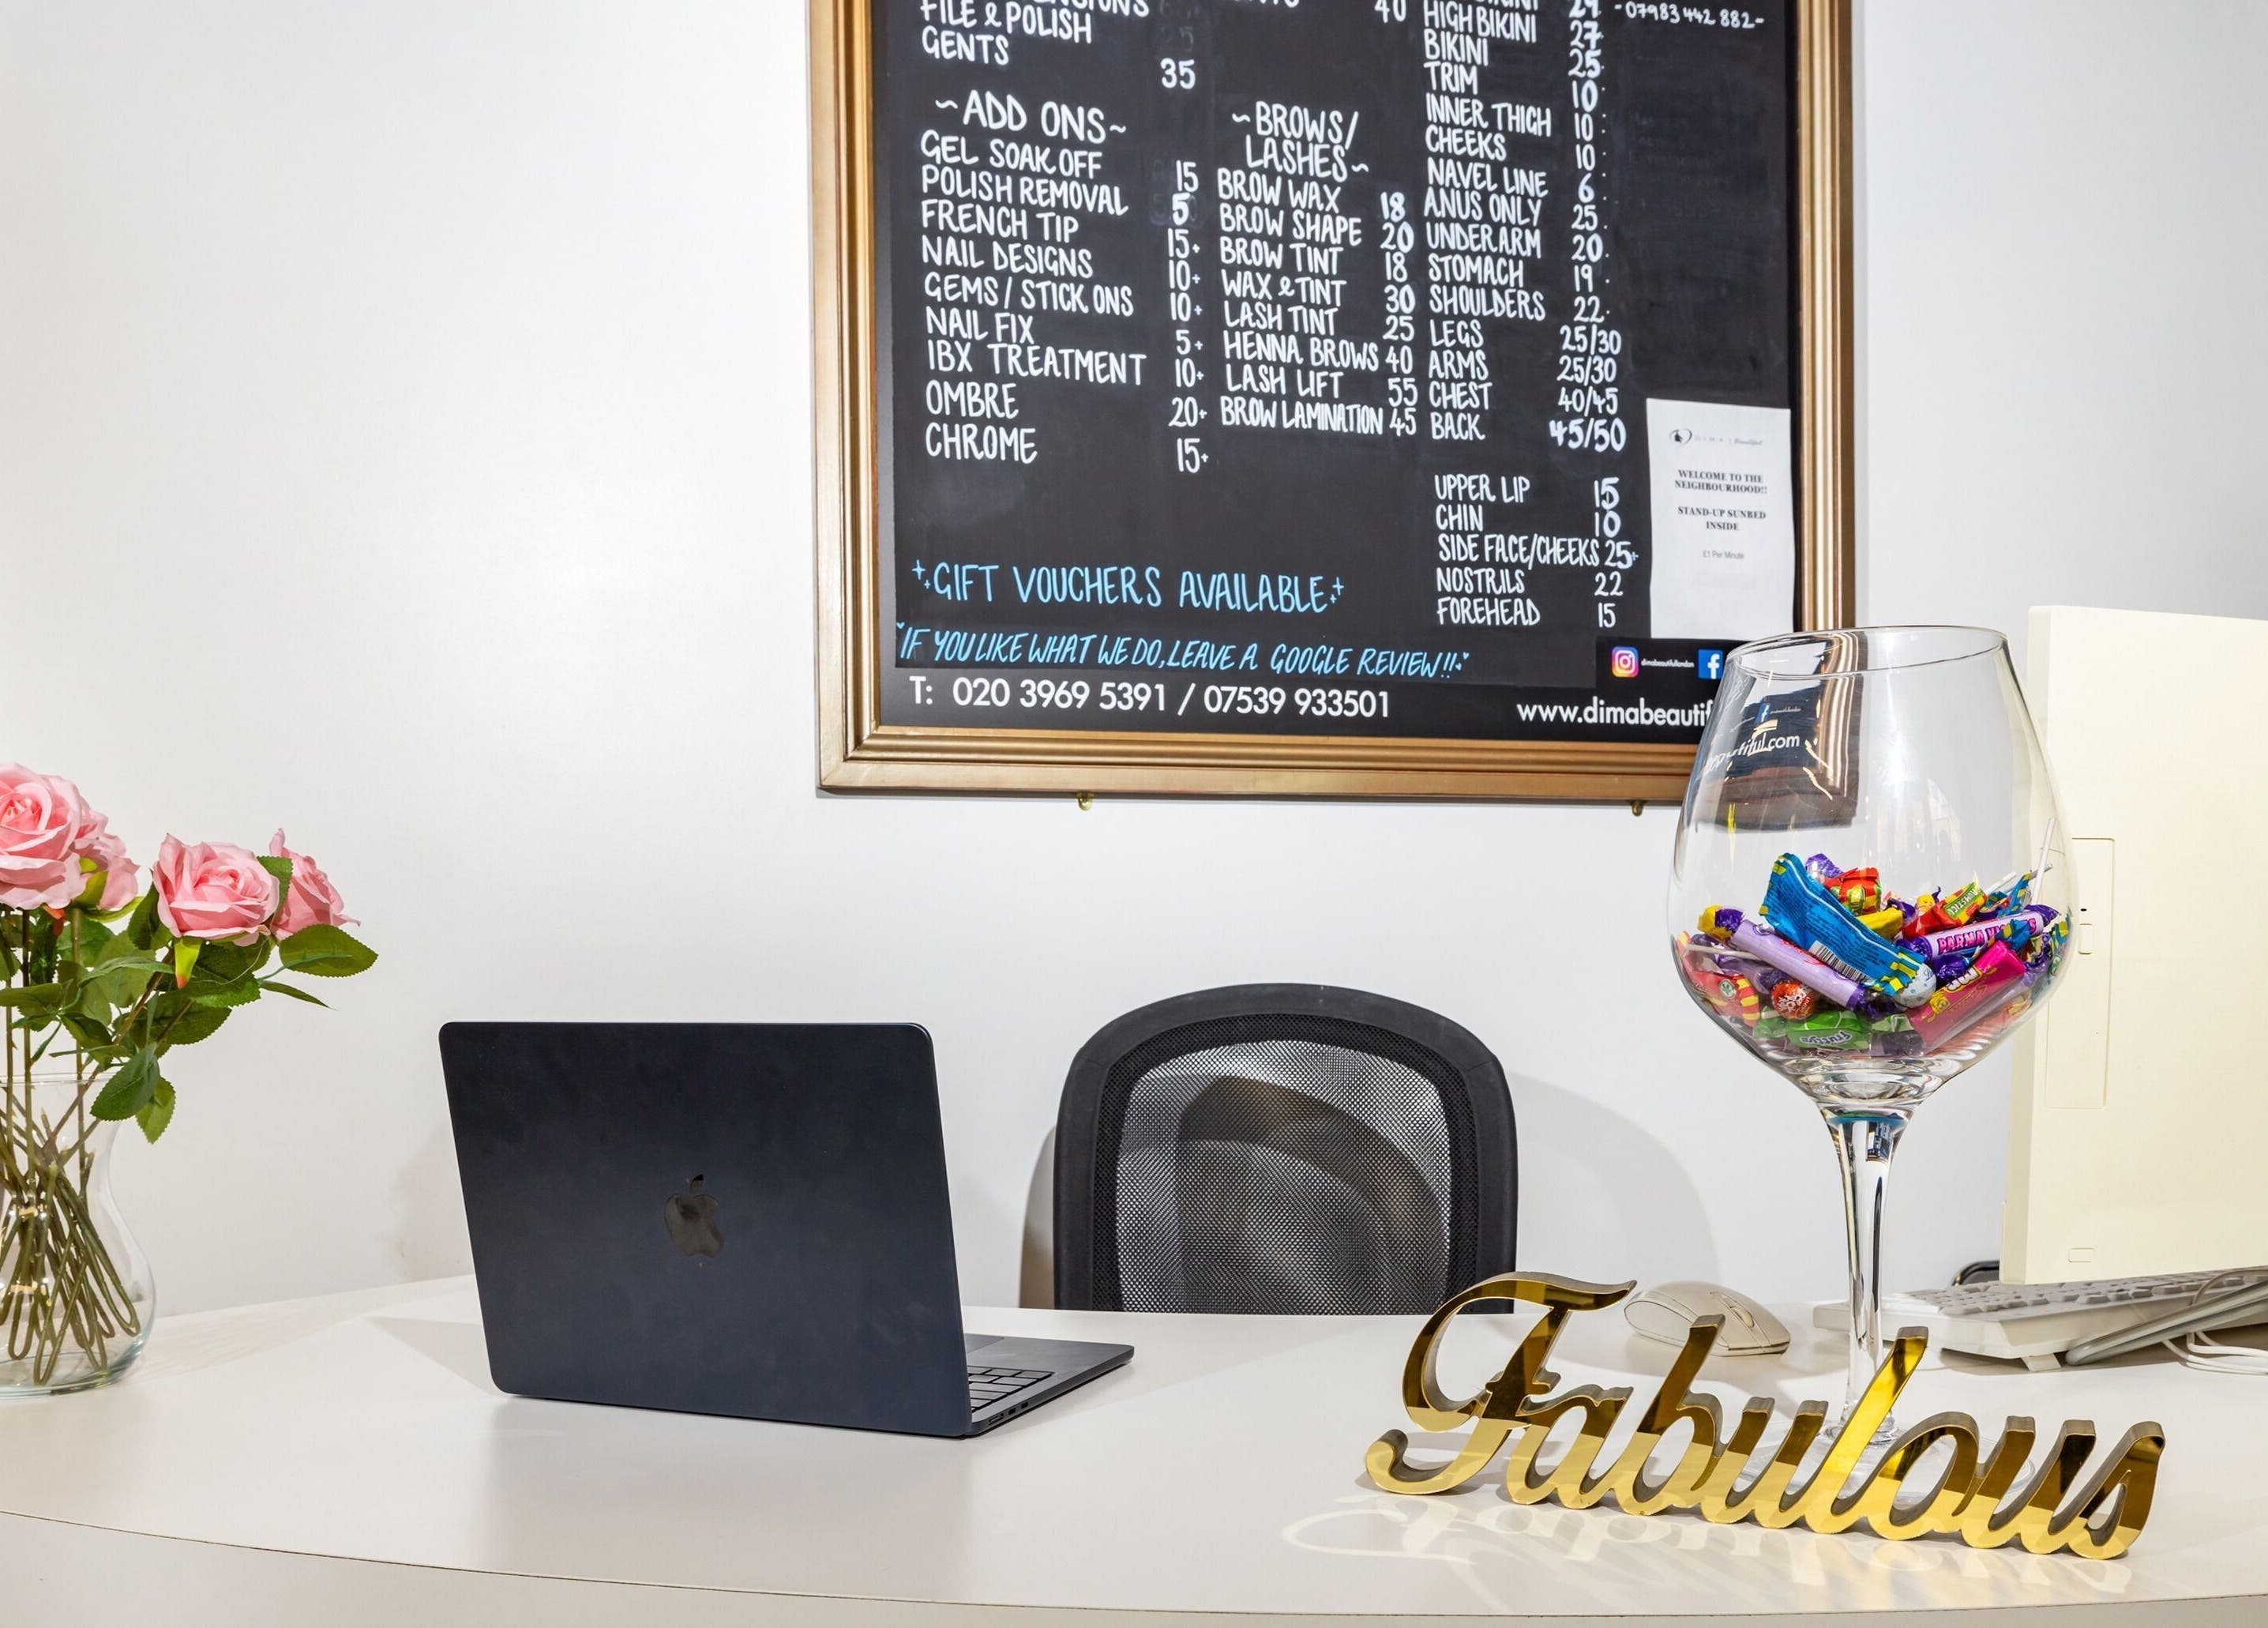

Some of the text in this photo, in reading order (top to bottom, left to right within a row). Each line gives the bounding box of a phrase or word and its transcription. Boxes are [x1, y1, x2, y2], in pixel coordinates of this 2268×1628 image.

[985, 2, 1002, 27] &
[1006, 2, 1092, 43] POLISH
[1374, 0, 1407, 23] 40
[1423, 0, 1602, 50] HIGH BIKINI 27
[1683, 7, 1716, 25] 442
[922, 25, 1196, 90] GENTS 35
[1424, 28, 1601, 78] BIKINI 25
[1423, 61, 1598, 112] TRIM 10
[1426, 92, 1594, 142] INNER THIGH 10
[921, 130, 1199, 192] GEL SOAK OFF 15
[1425, 124, 1595, 171] CHEEKS 10
[922, 164, 1012, 203] POLISH
[1019, 176, 1128, 216] REMOVAL
[1218, 167, 1405, 223] BROW WAX 18
[1427, 157, 1594, 203] NAVEL LINE 6
[922, 198, 1027, 240] FRENCH
[1036, 212, 1079, 243] TIP
[1220, 202, 1414, 253] BROW SHAPE 20
[1424, 186, 1598, 231] ANUS ONLY 25
[922, 235, 984, 269] NAIL
[993, 241, 1093, 278] DESIGNS
[1220, 236, 1407, 283] BROW TINT 18
[1571, 233, 1603, 262] 20
[1222, 269, 1416, 314] WAX & TINT 30
[1429, 253, 1593, 292] STOMACH 19
[925, 272, 998, 306] GEMS
[1020, 280, 1089, 313] STICK
[1093, 285, 1133, 317] ONS
[1429, 284, 1545, 321] SHOULDERS
[926, 306, 988, 340] NAIL
[995, 313, 1034, 344] FIX
[1225, 300, 1414, 341] LASH TINT 25
[1429, 319, 1621, 355] LEGS 25/30
[928, 340, 973, 372] IBX
[987, 343, 1147, 385] TREATMENT
[1224, 330, 1413, 374] HENNA BROWS 40
[1429, 350, 1617, 386] ARMS 25/30
[926, 379, 1019, 419] OMBRE
[1226, 363, 1418, 407] LASH LIFT 55
[1429, 382, 1619, 417] CHEST 40/45
[1221, 396, 1417, 436] BROW LAMINATION 45
[1430, 412, 1627, 452] BACK 45/50
[926, 422, 1037, 464] CHROME
[1435, 474, 1620, 509] UPPER LIP 15
[1675, 480, 1767, 494] NEIGHBOURHOOD!!
[1678, 469, 1726, 481] WELCOME
[1729, 473, 1741, 482] TO
[1435, 503, 1621, 538] CHIN 10
[1677, 507, 1767, 520] STAND-UP SUNBED
[1707, 521, 1740, 531] INSIDE
[1438, 533, 1479, 562] SIDE
[1484, 533, 1599, 570] FACE/CHEEKS
[933, 562, 1327, 613] GIFT VOUCHERS AVAILABLE
[1436, 566, 1624, 597] NOSTRILS 22
[1437, 596, 1616, 628] FOREHEAD 15
[899, 627, 931, 660] IF
[934, 630, 975, 662] YOU
[975, 632, 1028, 663] LIKE
[1028, 634, 1097, 664] WHAT
[1098, 634, 1132, 665] WE
[1166, 639, 1235, 671] LEAVE
[1238, 642, 1258, 671] A
[1270, 642, 1354, 675] GOOGLE
[1357, 648, 1455, 679] REVIEW!!
[909, 675, 1389, 718] T: 020 3969 5391 / 07539 933501
[1516, 695, 1714, 726] www.dimabeautif
[1937, 931, 1986, 953] PARMA
[1365, 1273, 2166, 1561] Fabulous
